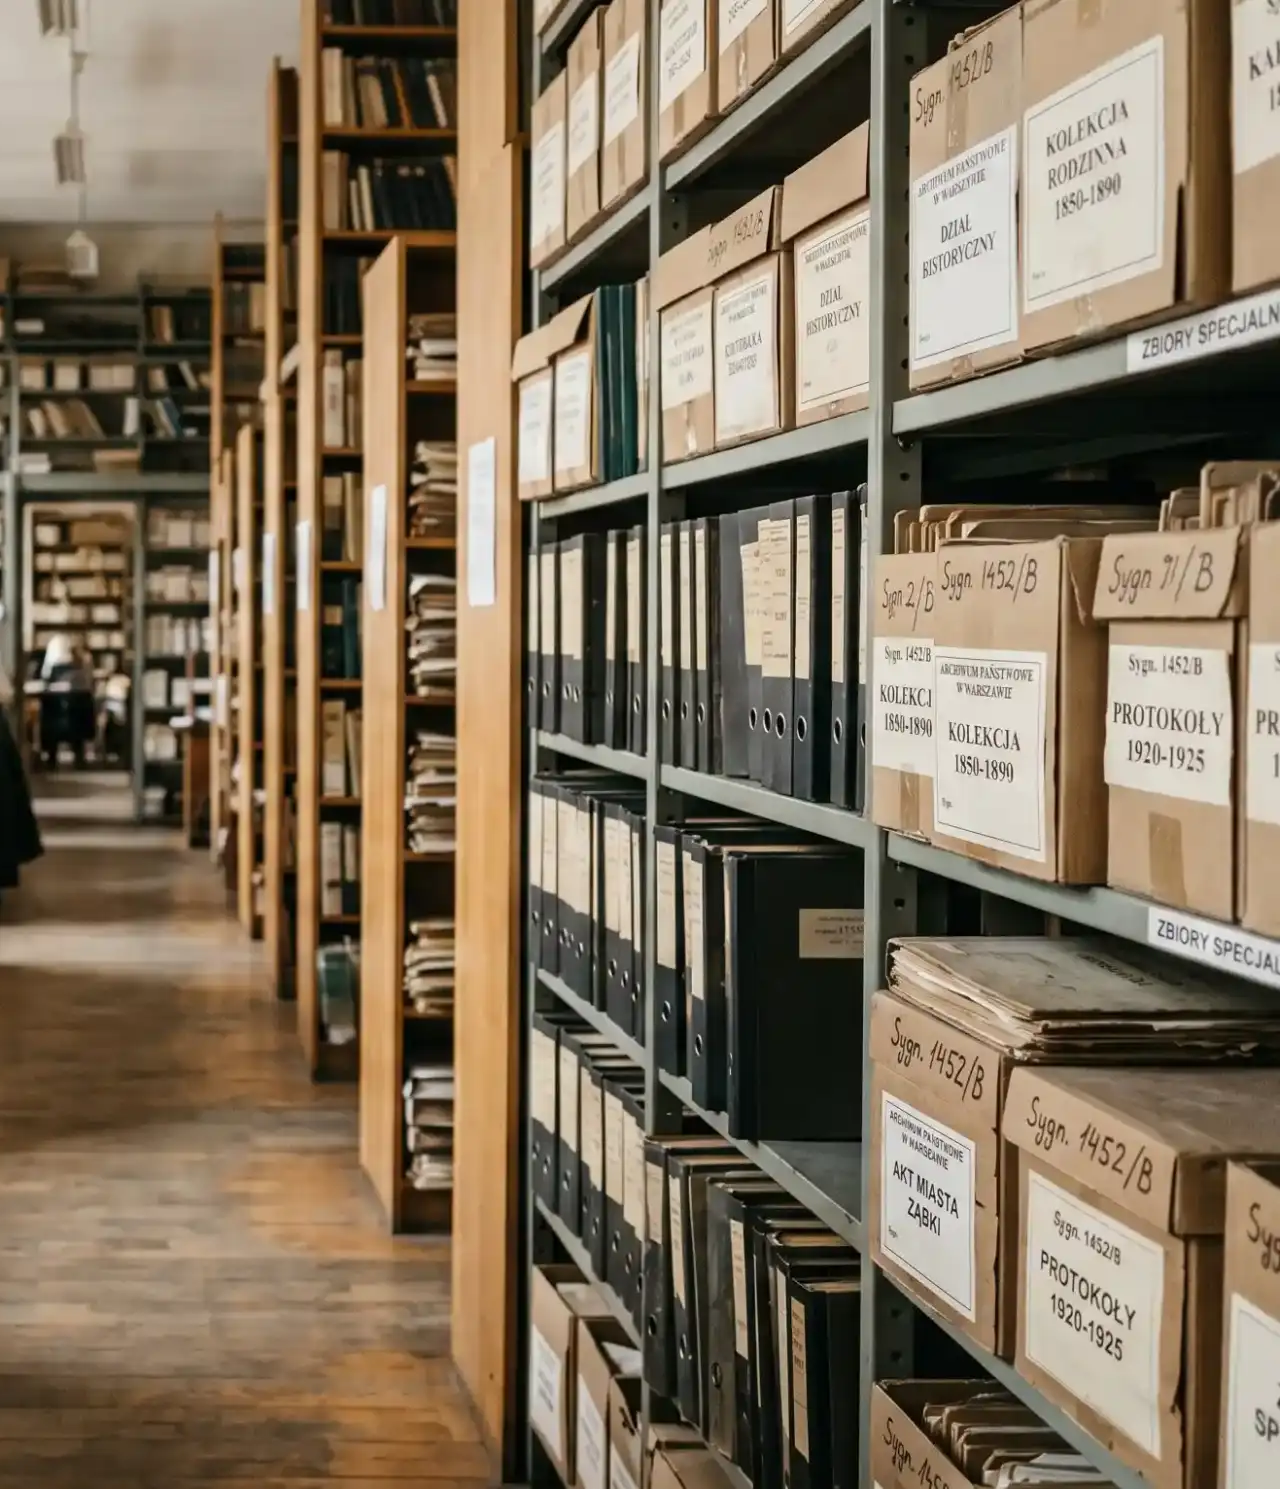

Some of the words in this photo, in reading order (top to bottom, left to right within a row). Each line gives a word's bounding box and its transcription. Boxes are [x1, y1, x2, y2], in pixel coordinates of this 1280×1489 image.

[1046, 99, 1129, 158] KOLEKCJA
[1048, 136, 1128, 191] RODZINNA
[1056, 172, 1122, 221] 1850-1890
[1142, 327, 1194, 359] ZBIORY
[941, 560, 973, 601] Sygn.
[982, 553, 1038, 603] 1452/B
[1109, 554, 1152, 605] Sygn
[1128, 654, 1157, 677] Sygn.
[1162, 655, 1203, 676] 1452/B
[948, 721, 1021, 751] KOLEKCJA
[1113, 701, 1224, 737] PROTOKOŁY
[954, 754, 1014, 783] 1850-1890
[1127, 739, 1206, 773] 1920-1925
[1157, 919, 1209, 951] ZBIORY
[891, 1016, 923, 1068] Sygn.
[930, 1040, 985, 1103] 1452/B
[1026, 1096, 1069, 1151] Sygn.
[1080, 1122, 1153, 1195] 1452/B
[893, 1160, 915, 1188] AKT
[916, 1173, 960, 1219] MIASTA
[907, 1196, 941, 1237] ZĄBKI
[1040, 1249, 1136, 1331] PROTOKOŁY
[1050, 1292, 1124, 1362] 1920-1925
